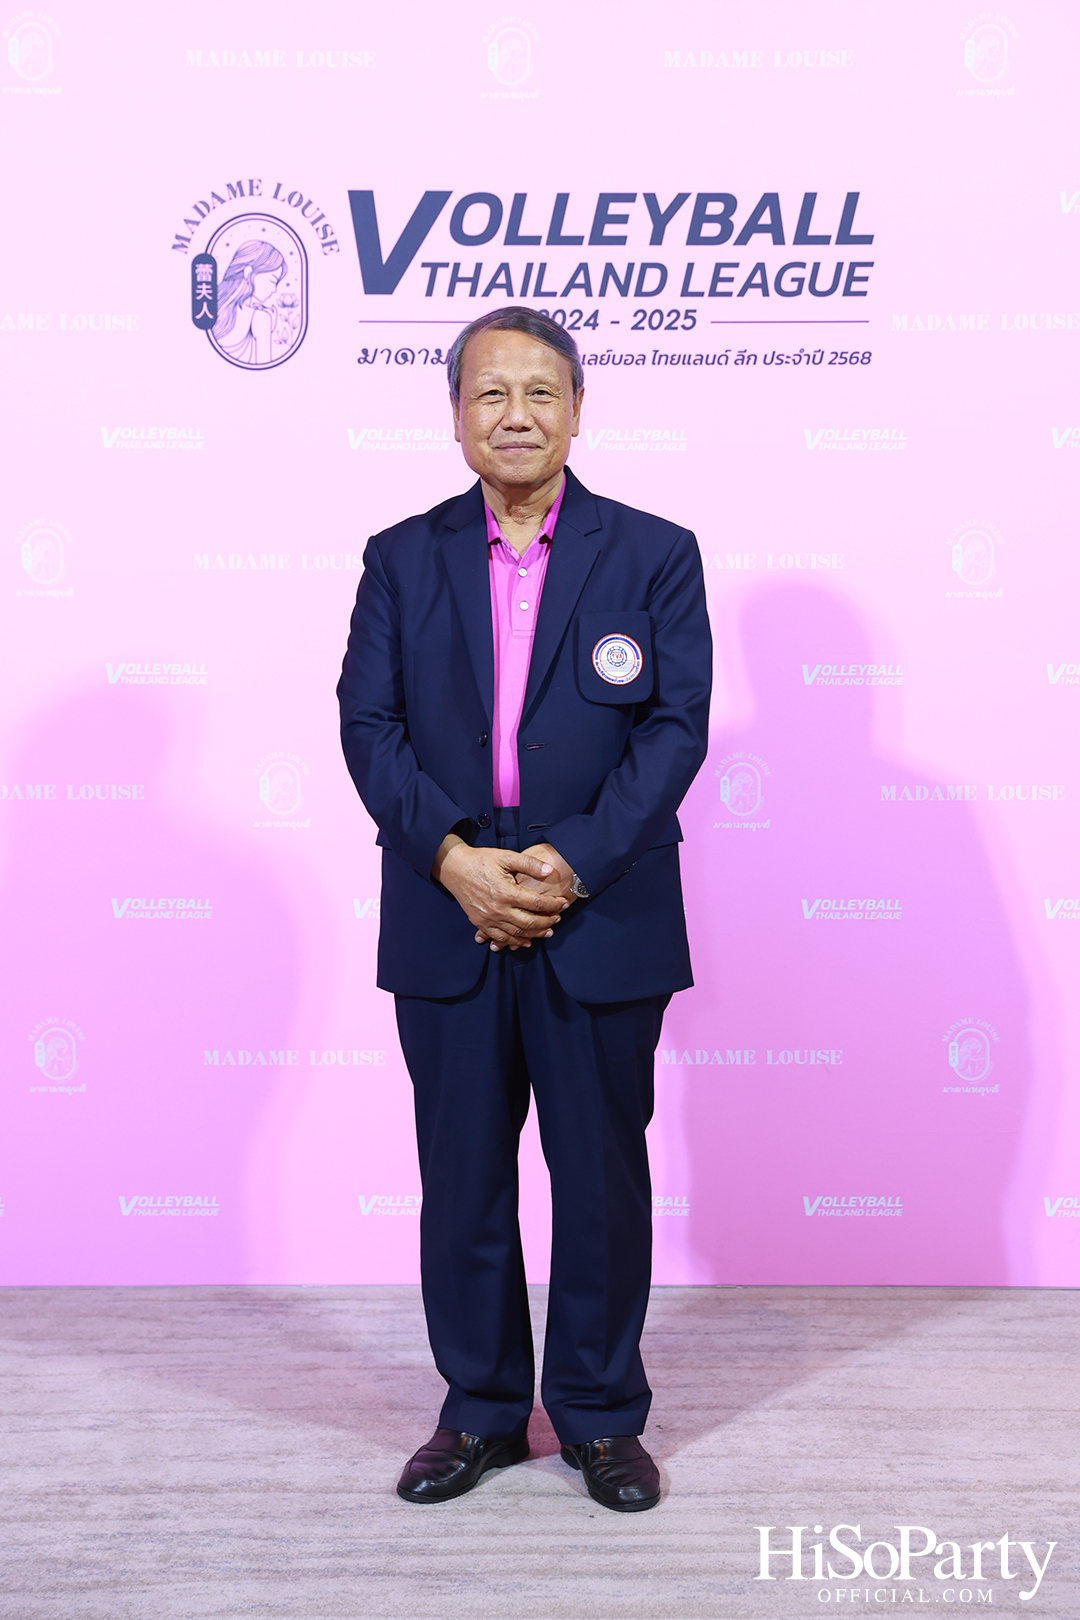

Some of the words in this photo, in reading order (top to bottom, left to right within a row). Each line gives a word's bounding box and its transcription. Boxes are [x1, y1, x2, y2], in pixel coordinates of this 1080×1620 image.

[186, 50, 286, 67] MADAME
[297, 50, 376, 68] LOUISE
[664, 50, 763, 67] MADAME
[775, 50, 854, 67] LOUISE
[171, 178, 263, 254] MADAME
[272, 182, 340, 256] LOUISE
[347, 190, 875, 295] VOLLEYBALL
[421, 262, 668, 297] THAILAND
[680, 261, 875, 297] LEAGUE
[195, 263, 214, 319] 蕾夫人
[0, 313, 49, 330] AME
[60, 314, 139, 330] LOUISE
[631, 309, 697, 331] 2025
[892, 314, 990, 331] MADAME
[1001, 314, 1080, 330] LOUISE
[357, 346, 451, 366] มาดาม
[582, 349, 646, 366] เลย์บอล
[651, 349, 731, 366] ไทยแลนด์
[734, 348, 757, 366] ลีก
[763, 348, 825, 366] ประจำปี
[828, 351, 873, 366] 2568
[101, 427, 204, 449] VOLLEYBALL
[115, 440, 164, 449] THAILAND
[164, 440, 204, 449] LEAGUE
[348, 429, 449, 450] VOLLEYBALL
[362, 441, 410, 450] THAILAND
[412, 441, 449, 450] LEAGUE
[586, 429, 687, 450] VOLLEYBALL
[600, 441, 648, 450] THAILAND
[650, 441, 687, 450] LEAGUE
[805, 429, 907, 450] VOLLEYBALL
[819, 441, 868, 450] THAILAND
[868, 441, 907, 450] LEAGUE
[194, 554, 290, 570] MADAME
[302, 554, 363, 570] LOUIS
[703, 553, 756, 569] AME
[767, 553, 844, 569] LOUISE
[106, 663, 208, 685] VOLLEYBALL
[120, 676, 168, 685] THAILAND
[170, 676, 208, 685] LEAGUE
[803, 664, 904, 685] VOLLEYBALL
[817, 676, 866, 685] THAILAND
[866, 676, 904, 685] LEAGUE
[67, 784, 144, 801] LOUISE
[881, 784, 979, 801] MADAME
[988, 784, 1066, 801] LOUISE
[111, 898, 212, 919] VOLLEYBALL
[125, 910, 174, 919] THAILAND
[174, 910, 212, 919] LEAGUE
[802, 899, 902, 919] VOLLEYBALL
[816, 910, 864, 919] THAILAND
[866, 910, 902, 919] LEAGUE
[204, 1050, 299, 1066] MADAME
[310, 1050, 386, 1066] LOUISE
[661, 1050, 755, 1066] MADAME
[767, 1050, 843, 1066] LOUISE
[119, 1196, 219, 1216] VOLLEYBALL
[133, 1207, 182, 1216] THAILAND
[182, 1207, 219, 1216] LEAGUE
[359, 1195, 421, 1216] VOLLEY
[803, 1196, 903, 1216] VOLLEYBALL
[817, 1207, 866, 1216] THAILAND
[866, 1207, 903, 1216] LEAGUE
